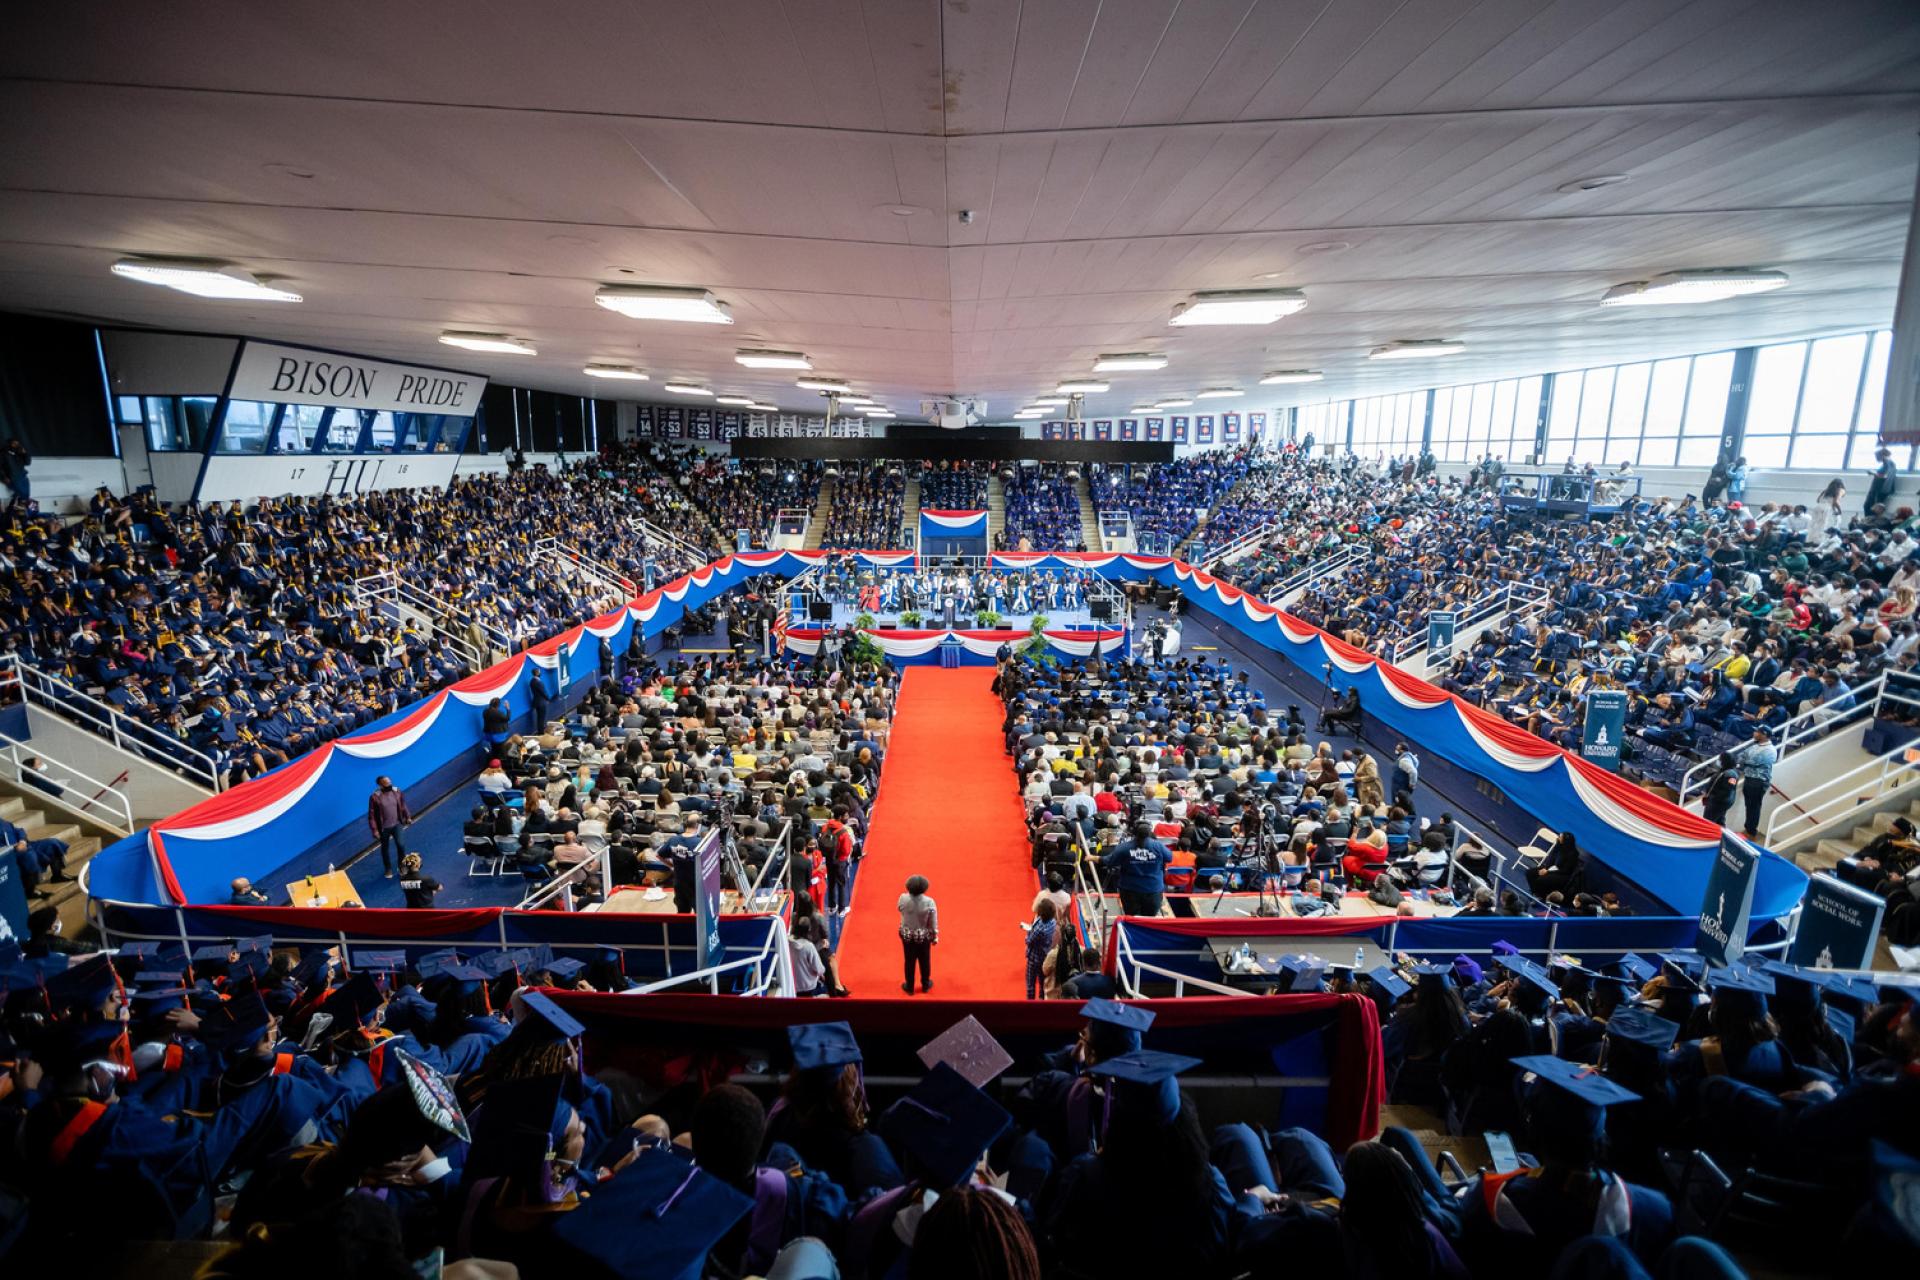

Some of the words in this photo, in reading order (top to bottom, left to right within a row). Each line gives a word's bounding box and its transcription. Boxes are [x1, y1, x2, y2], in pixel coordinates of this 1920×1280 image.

[269, 357, 379, 400] BISON
[395, 374, 468, 407] PRIDE
[290, 468, 305, 480] 17
[325, 459, 384, 495] HU
[1811, 899, 1839, 917] SOCIAL
[1838, 911, 1863, 928] WORK
[1817, 894, 1848, 912] SCHOOL
[1848, 907, 1860, 917] OF
